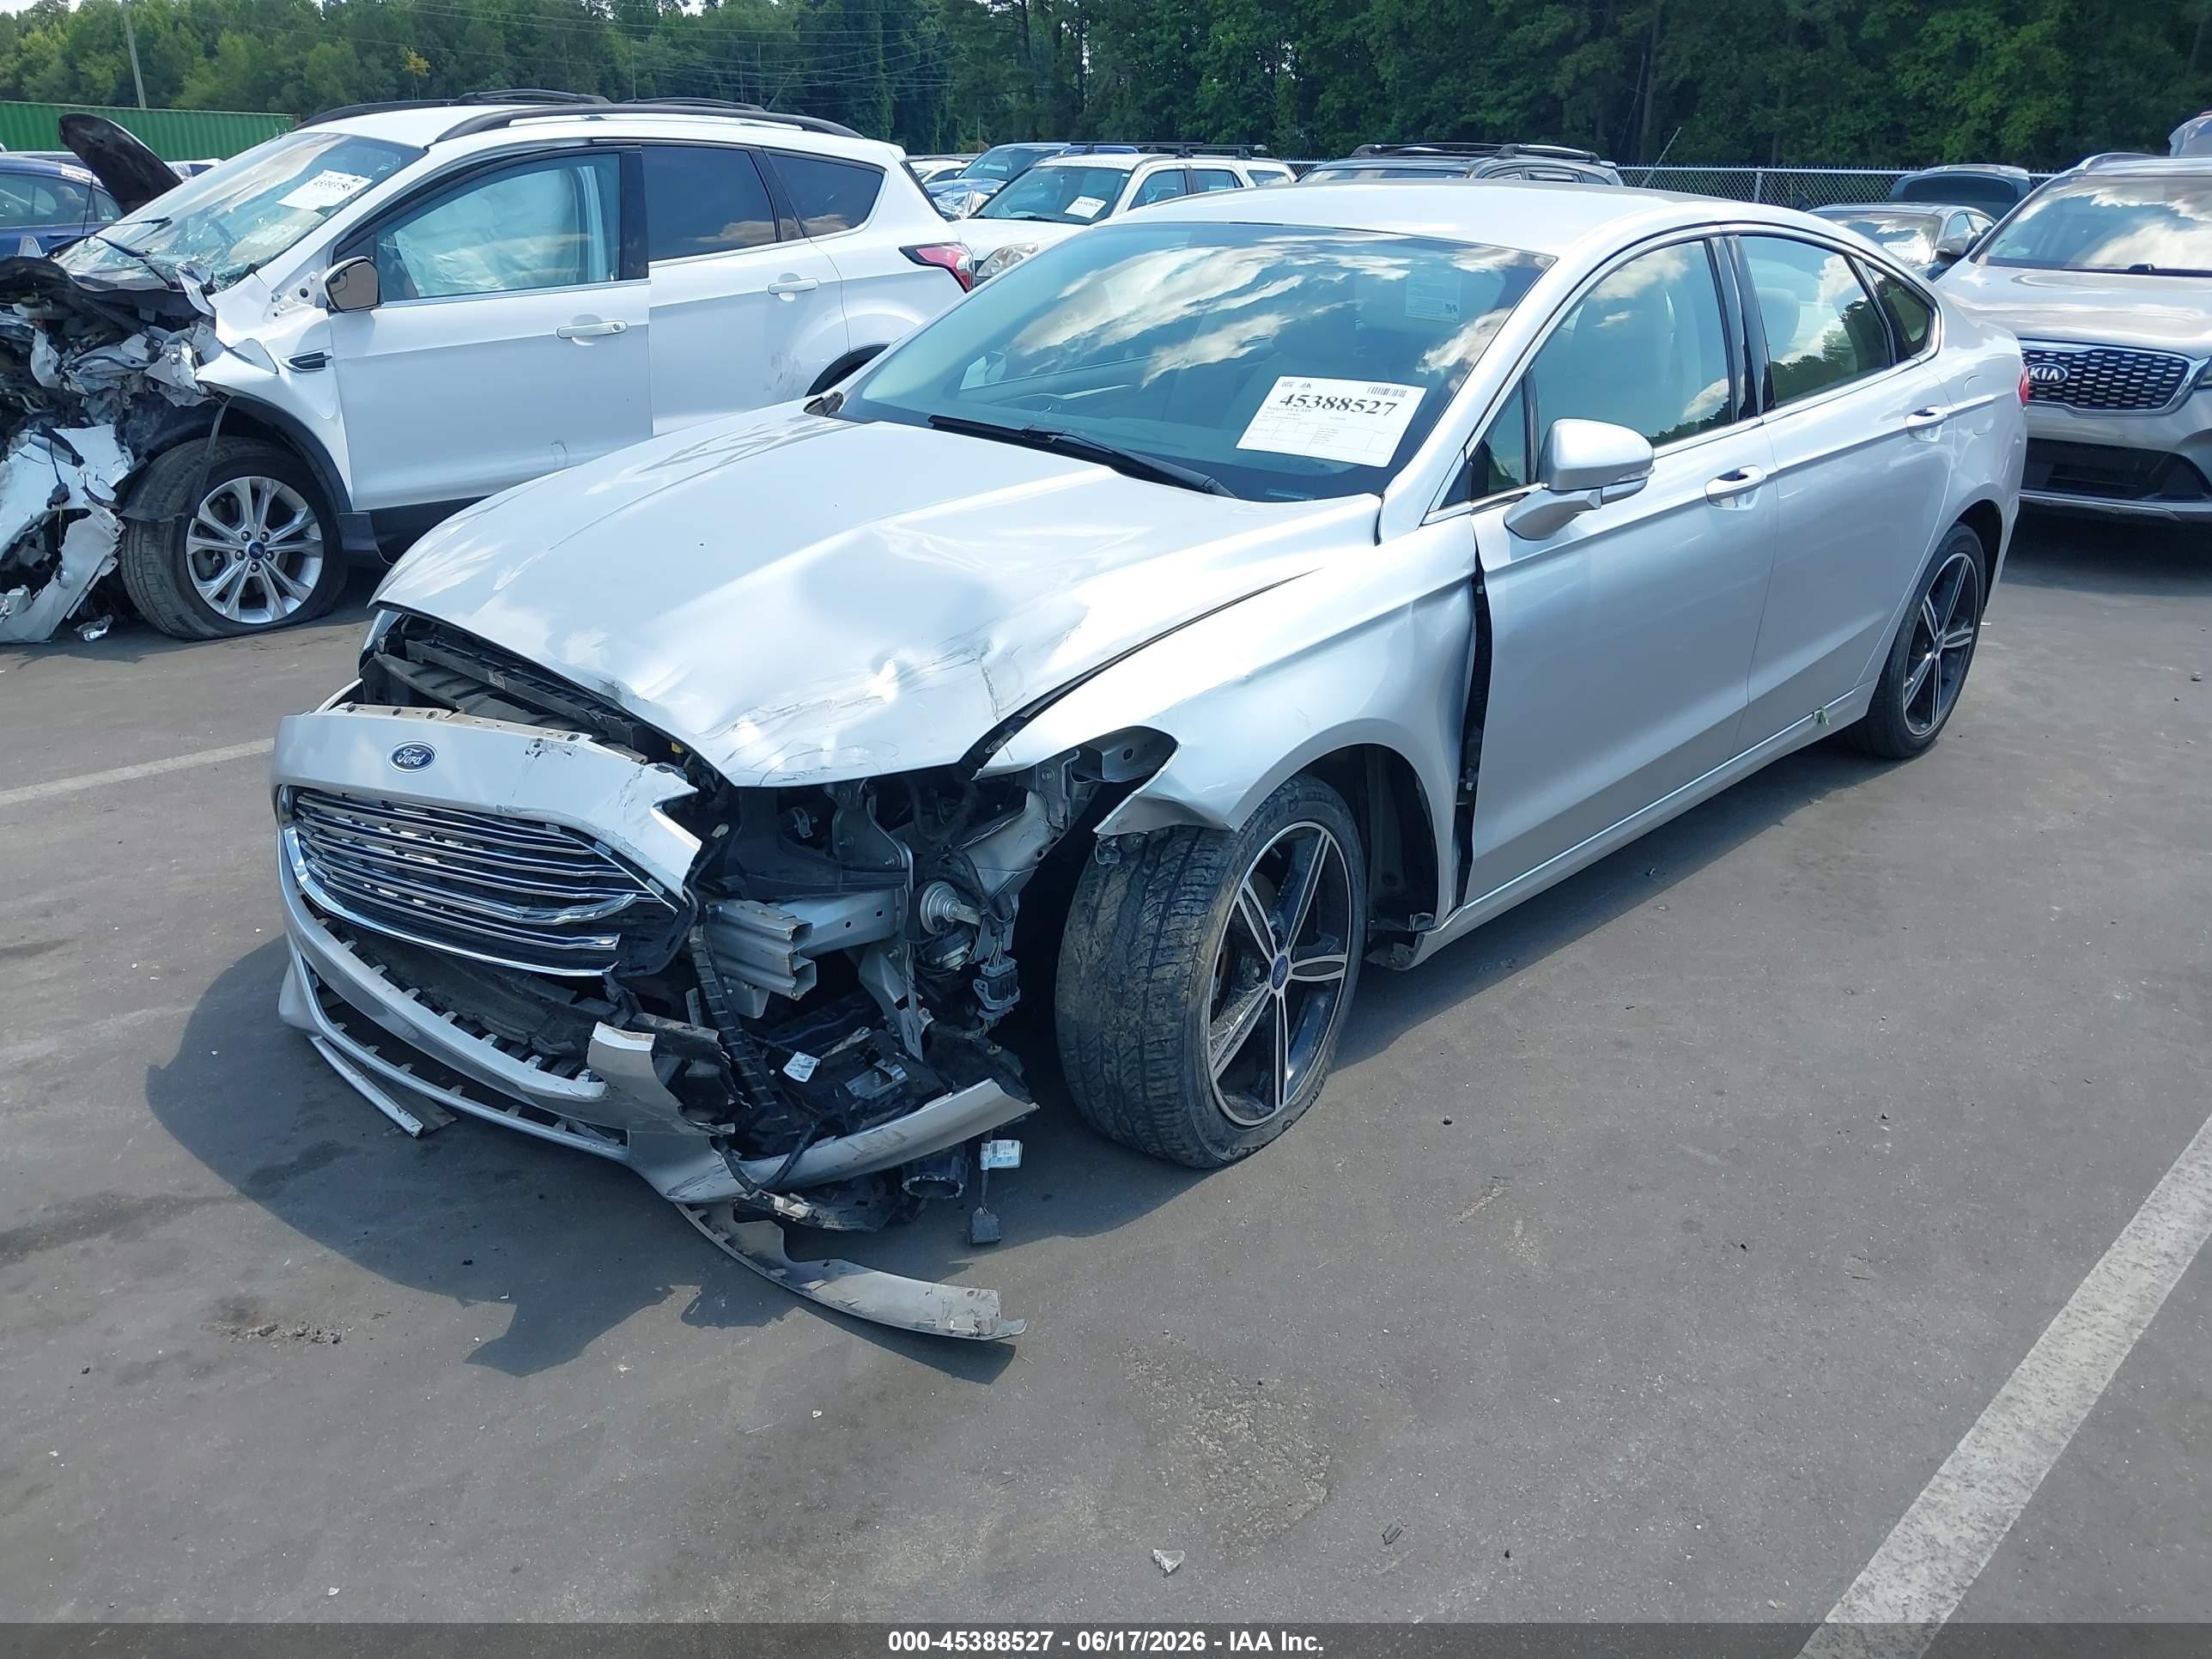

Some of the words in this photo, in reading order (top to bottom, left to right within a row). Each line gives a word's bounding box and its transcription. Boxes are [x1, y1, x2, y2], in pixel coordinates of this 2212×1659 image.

[2030, 367, 2058, 380] KIA
[1279, 392, 1399, 416] 45388527
[397, 747, 427, 765] Ford
